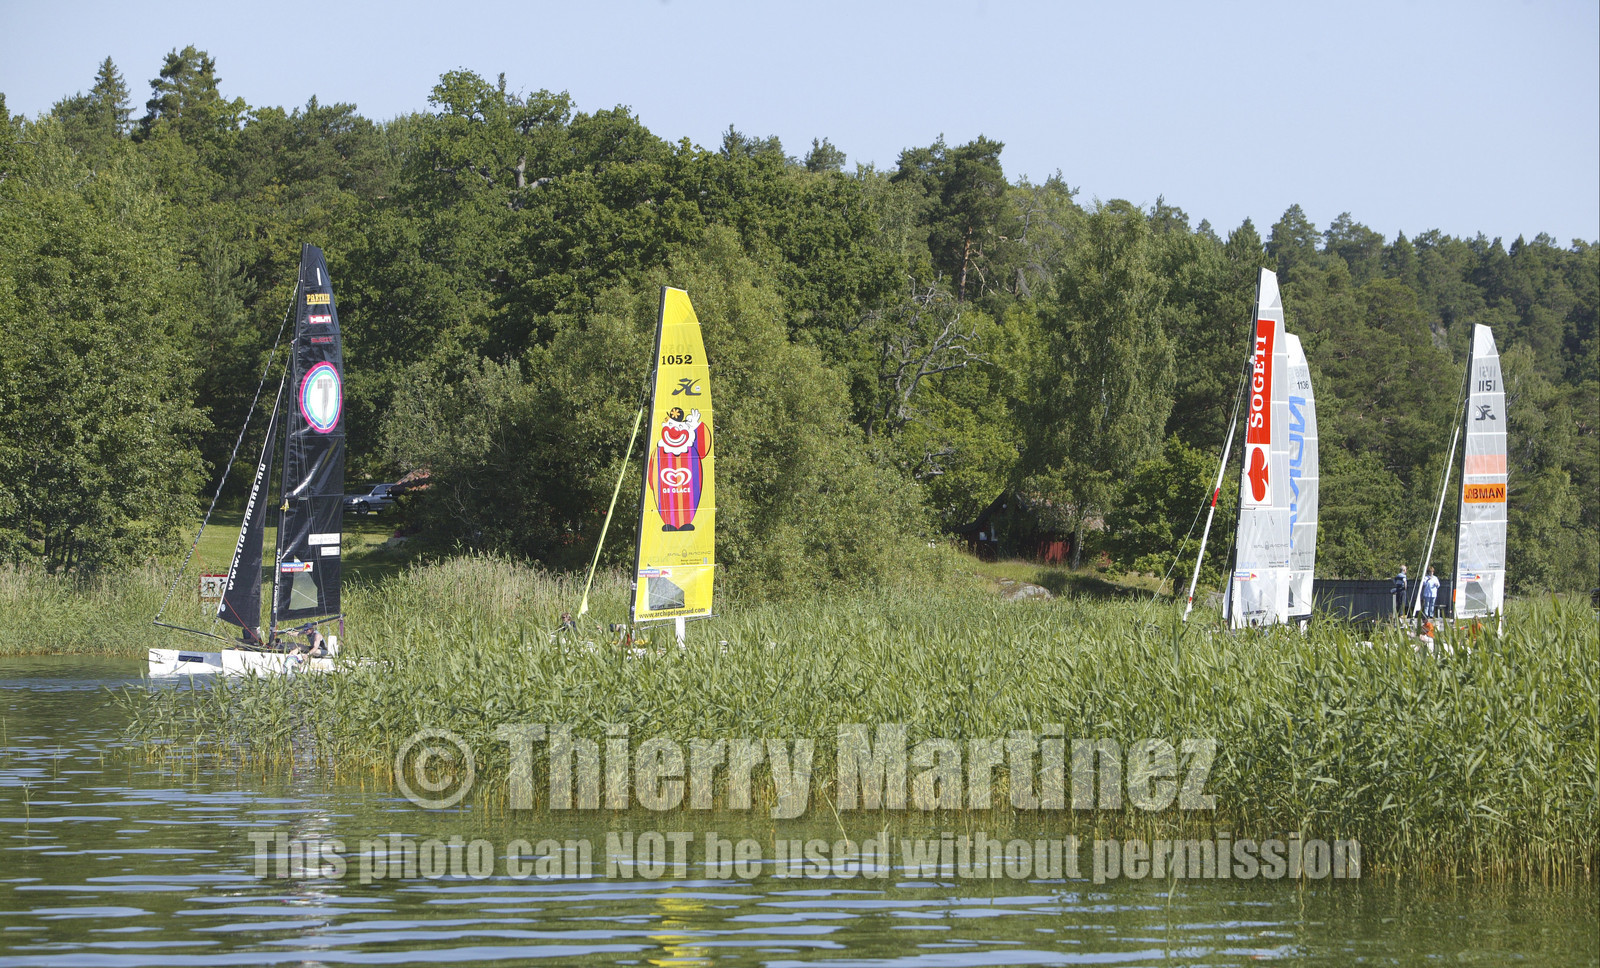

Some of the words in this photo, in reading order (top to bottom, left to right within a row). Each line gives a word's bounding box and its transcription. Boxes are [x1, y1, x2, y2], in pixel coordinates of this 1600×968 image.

[662, 354, 692, 366] 1052
[1251, 335, 1267, 429] SOGETI
[1479, 380, 1496, 392] 1151
[228, 463, 266, 591] www.tidermans.nu
